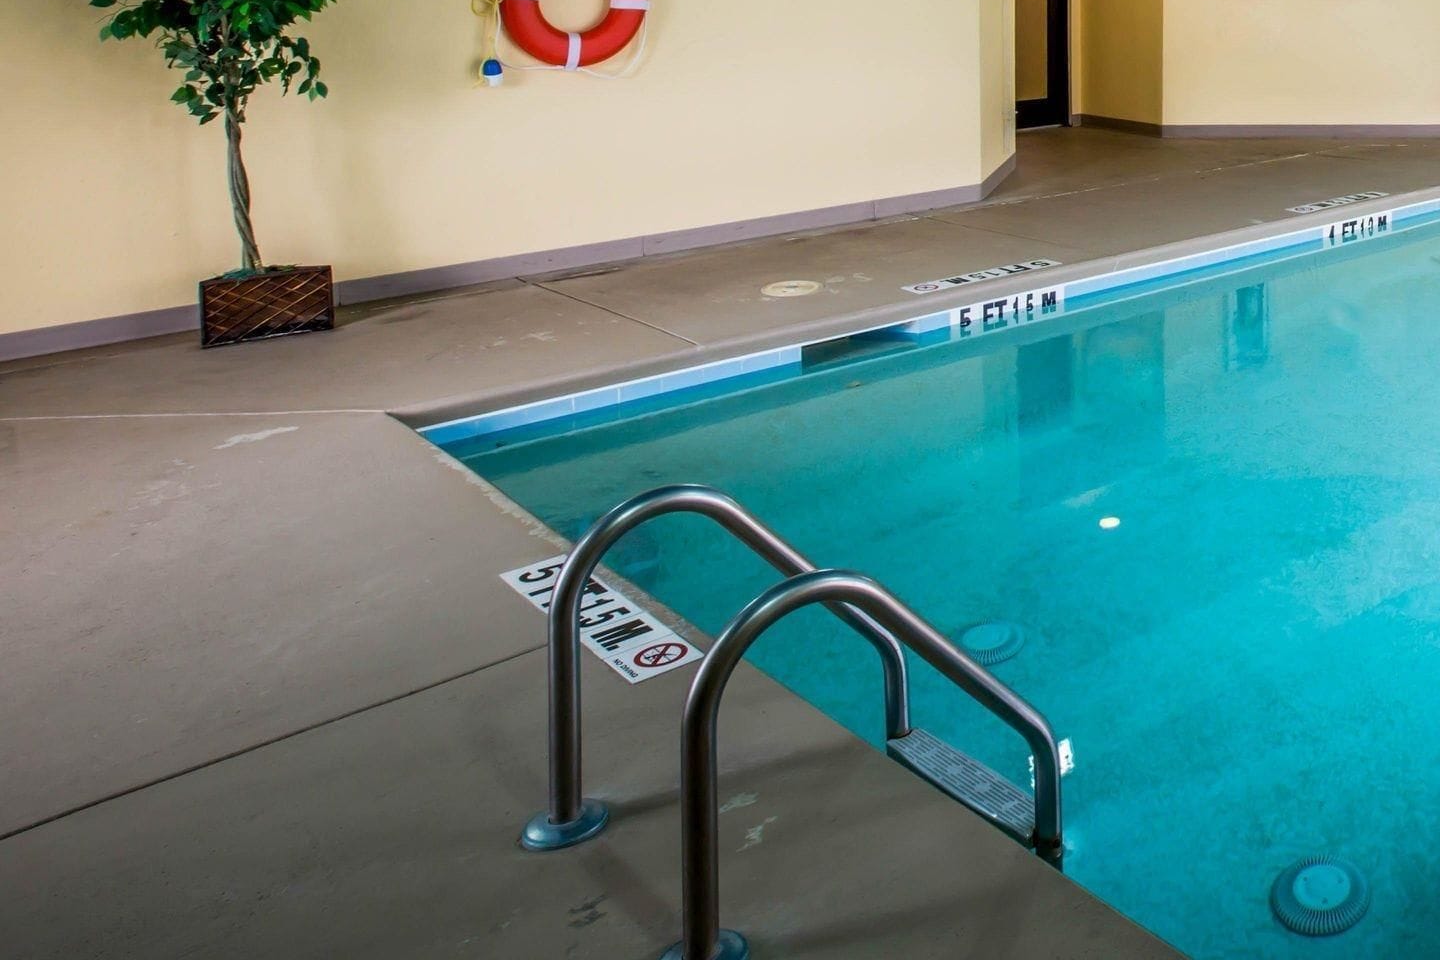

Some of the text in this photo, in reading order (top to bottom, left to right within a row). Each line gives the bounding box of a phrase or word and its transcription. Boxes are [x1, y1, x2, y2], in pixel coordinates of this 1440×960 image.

[1342, 220, 1357, 235] FT
[960, 308, 971, 328] 5
[983, 299, 1008, 322] FT
[519, 563, 564, 583] 5
